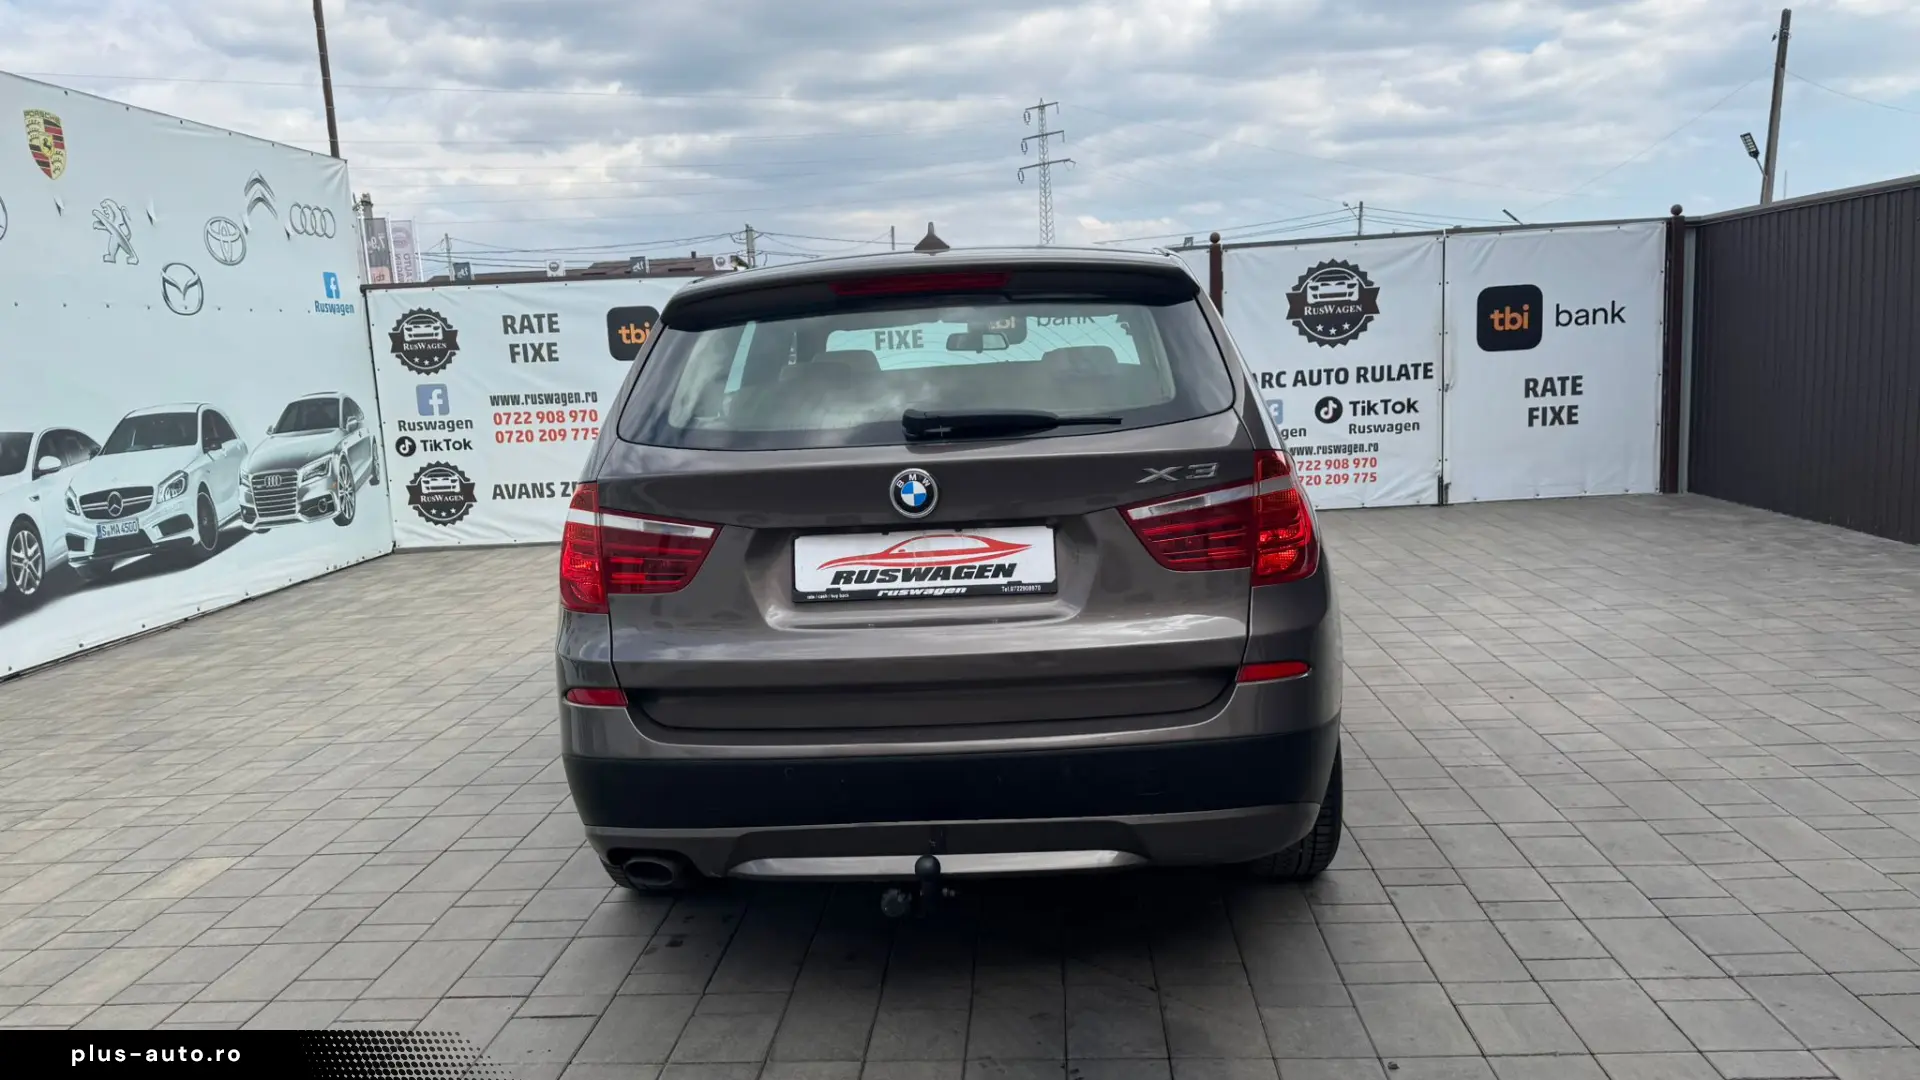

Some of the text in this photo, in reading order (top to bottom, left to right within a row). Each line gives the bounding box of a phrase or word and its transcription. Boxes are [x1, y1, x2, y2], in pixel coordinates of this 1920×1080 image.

[314, 300, 355, 316] Ruswagen
[1555, 300, 1626, 328] bank
[502, 313, 560, 335] RATE
[1489, 304, 1530, 332] tbi
[874, 329, 924, 350] FIXE
[509, 342, 560, 364] FIXE
[1292, 368, 1349, 387] AUTO
[1356, 362, 1434, 383] RULATE
[1524, 375, 1583, 399] RATE
[489, 392, 598, 407] www.ruswagen.ro
[1349, 398, 1419, 416] TikTok
[493, 409, 598, 425] 0722 908 970
[1527, 404, 1580, 428] FIXE
[397, 419, 474, 432] Ruswagen
[1349, 421, 1420, 435] Ruswagen
[495, 427, 599, 444] 0720 209 775
[420, 438, 473, 452] TikTok
[1289, 442, 1379, 456] www.ruswagen.ro
[1325, 459, 1349, 470] 908
[1353, 457, 1377, 468] 970
[896, 473, 930, 488] BMW
[1136, 462, 1219, 484] X3
[1325, 474, 1349, 485] 209
[1353, 472, 1377, 483] 775
[492, 481, 556, 500] AVANS
[831, 562, 1017, 585] RUSWAGEN
[877, 587, 967, 597] ruswagen
